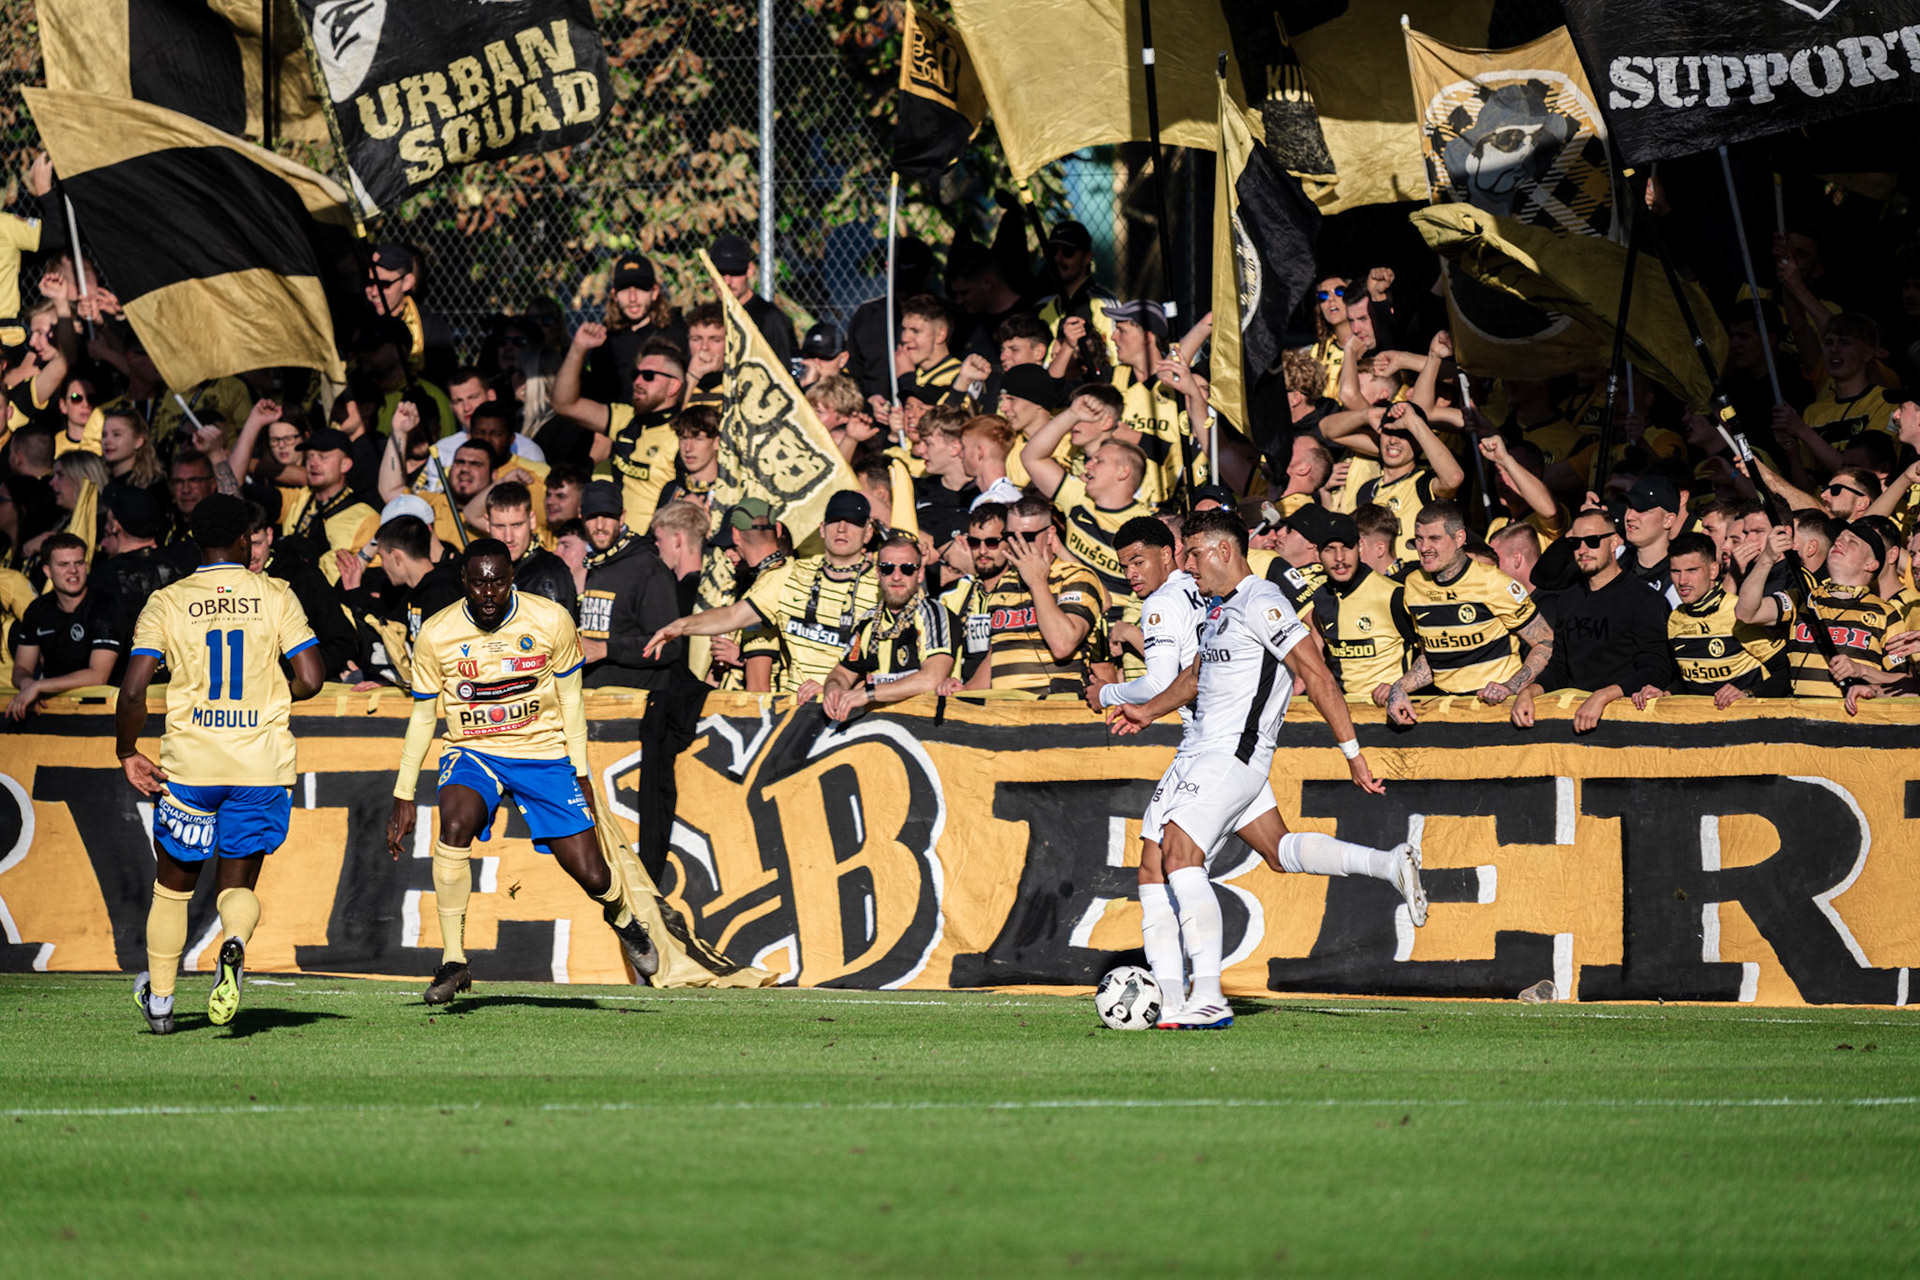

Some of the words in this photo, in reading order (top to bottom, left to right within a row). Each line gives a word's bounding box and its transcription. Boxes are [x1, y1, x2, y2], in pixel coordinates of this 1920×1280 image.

[355, 18, 576, 141] URBAN
[399, 70, 600, 186] SQUAD
[188, 597, 262, 618] OBRIST
[784, 619, 850, 648] Plus50
[206, 629, 244, 700] 11
[192, 707, 259, 728] MOBULU
[460, 700, 540, 726] PRODIS
[948, 775, 1920, 1006] BER
